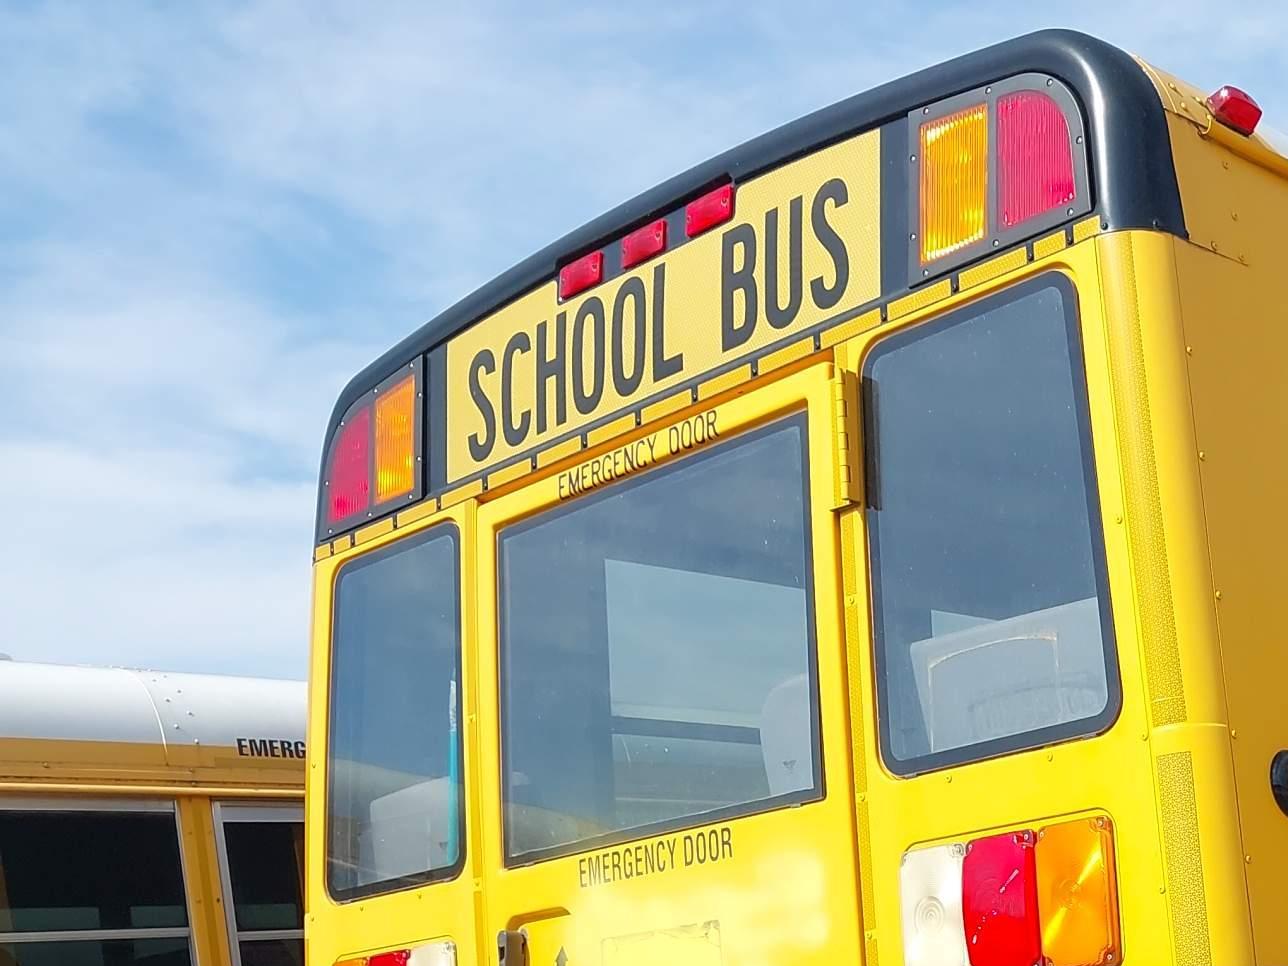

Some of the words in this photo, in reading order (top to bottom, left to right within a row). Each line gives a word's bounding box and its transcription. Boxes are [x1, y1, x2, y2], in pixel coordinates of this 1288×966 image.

[468, 262, 684, 463] SCHOOL
[721, 178, 849, 353] BUS
[558, 433, 658, 500] EMERGENCY
[668, 410, 720, 456] DOOR
[578, 838, 677, 888] EMERGENCY
[683, 827, 733, 867] DOOR
